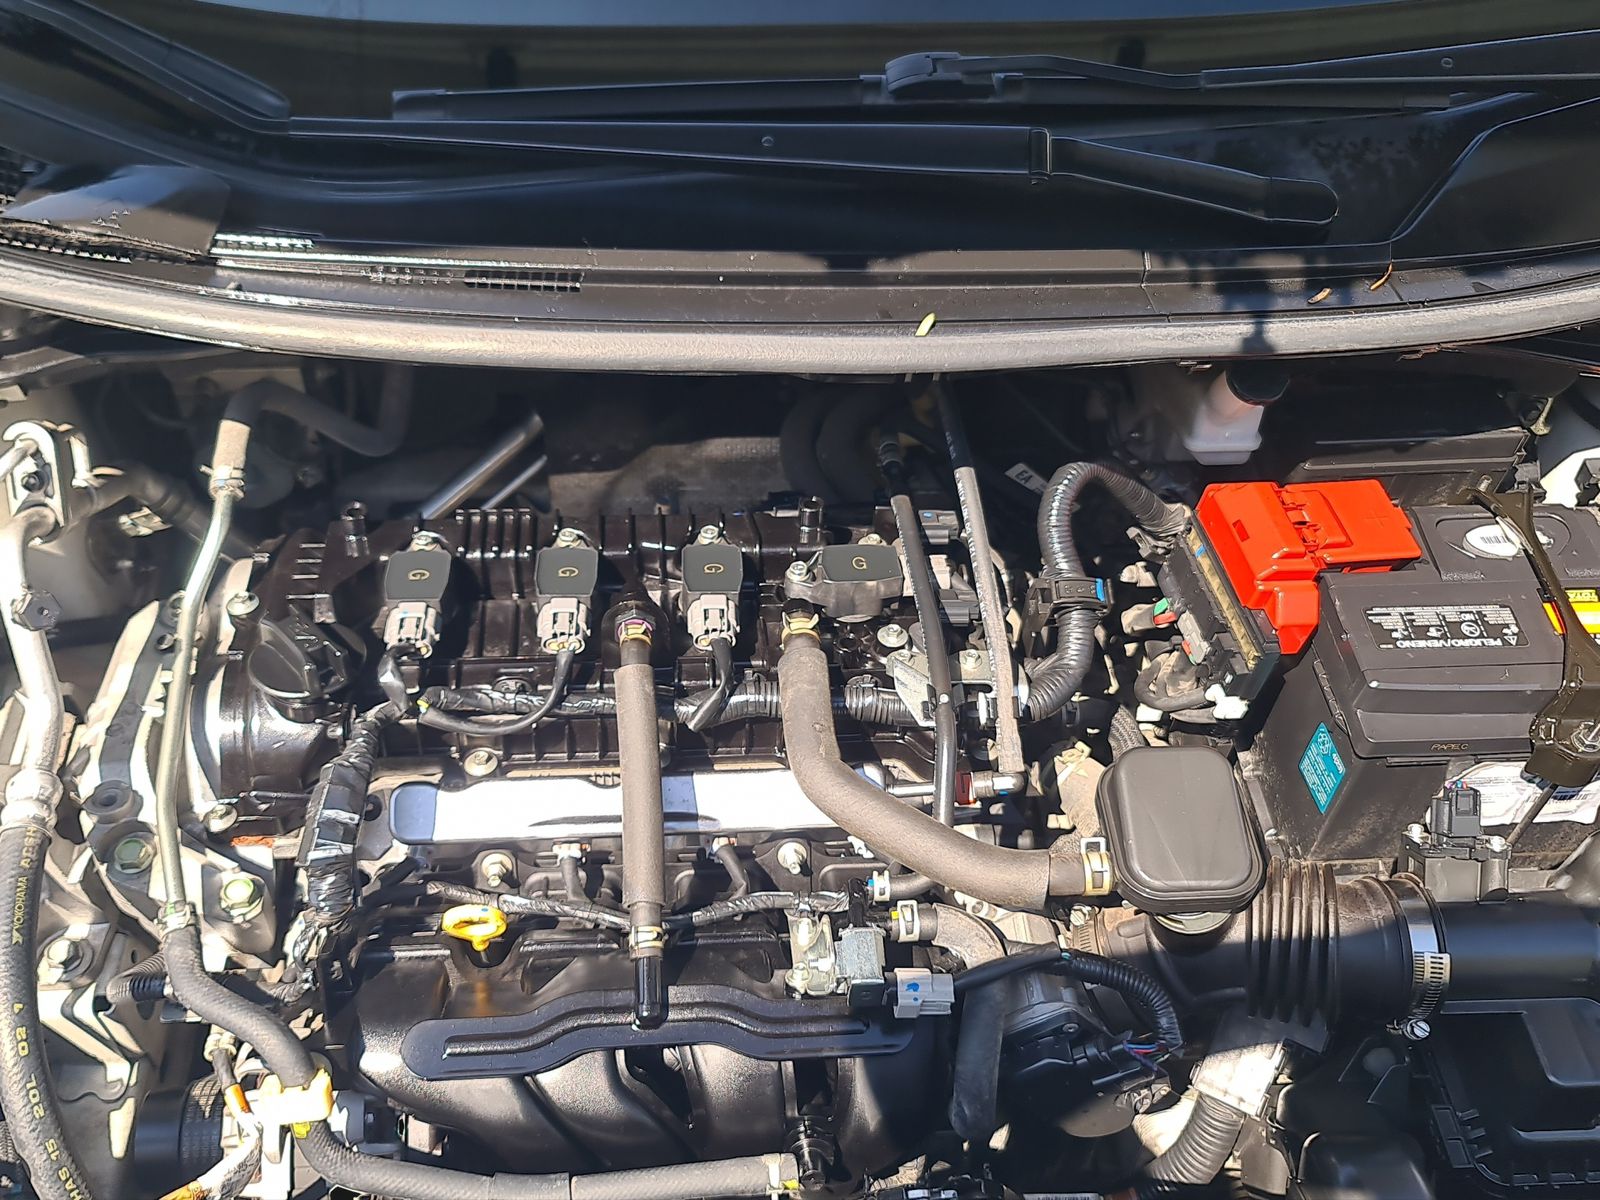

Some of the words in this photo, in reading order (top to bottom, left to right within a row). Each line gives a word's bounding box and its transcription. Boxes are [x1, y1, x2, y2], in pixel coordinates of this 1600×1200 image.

[1015, 469, 1033, 485] EA
[703, 563, 725, 574] G
[852, 556, 867, 570] G
[407, 569, 430, 581] G
[558, 567, 581, 577] G
[13, 875, 28, 931] YOKOHAMA
[44, 1138, 61, 1161] 15
